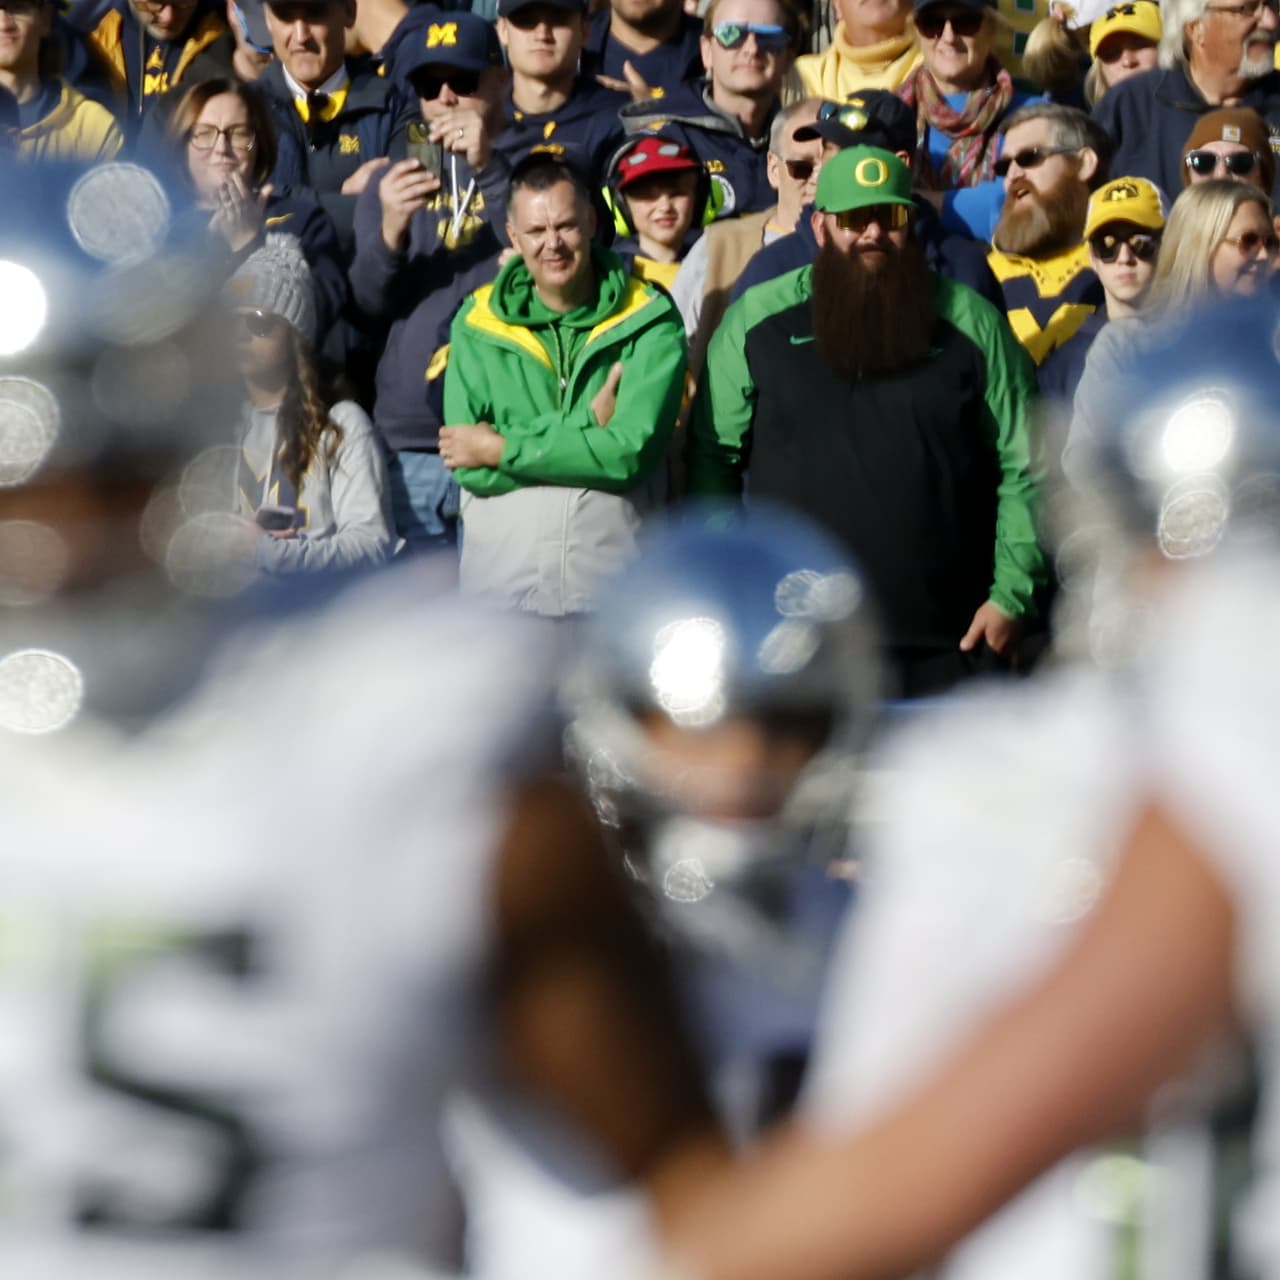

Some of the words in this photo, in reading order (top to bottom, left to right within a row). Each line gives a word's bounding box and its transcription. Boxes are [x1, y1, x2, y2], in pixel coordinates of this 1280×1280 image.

[1105, 4, 1136, 20] M
[426, 23, 457, 47] M
[854, 159, 889, 187] O
